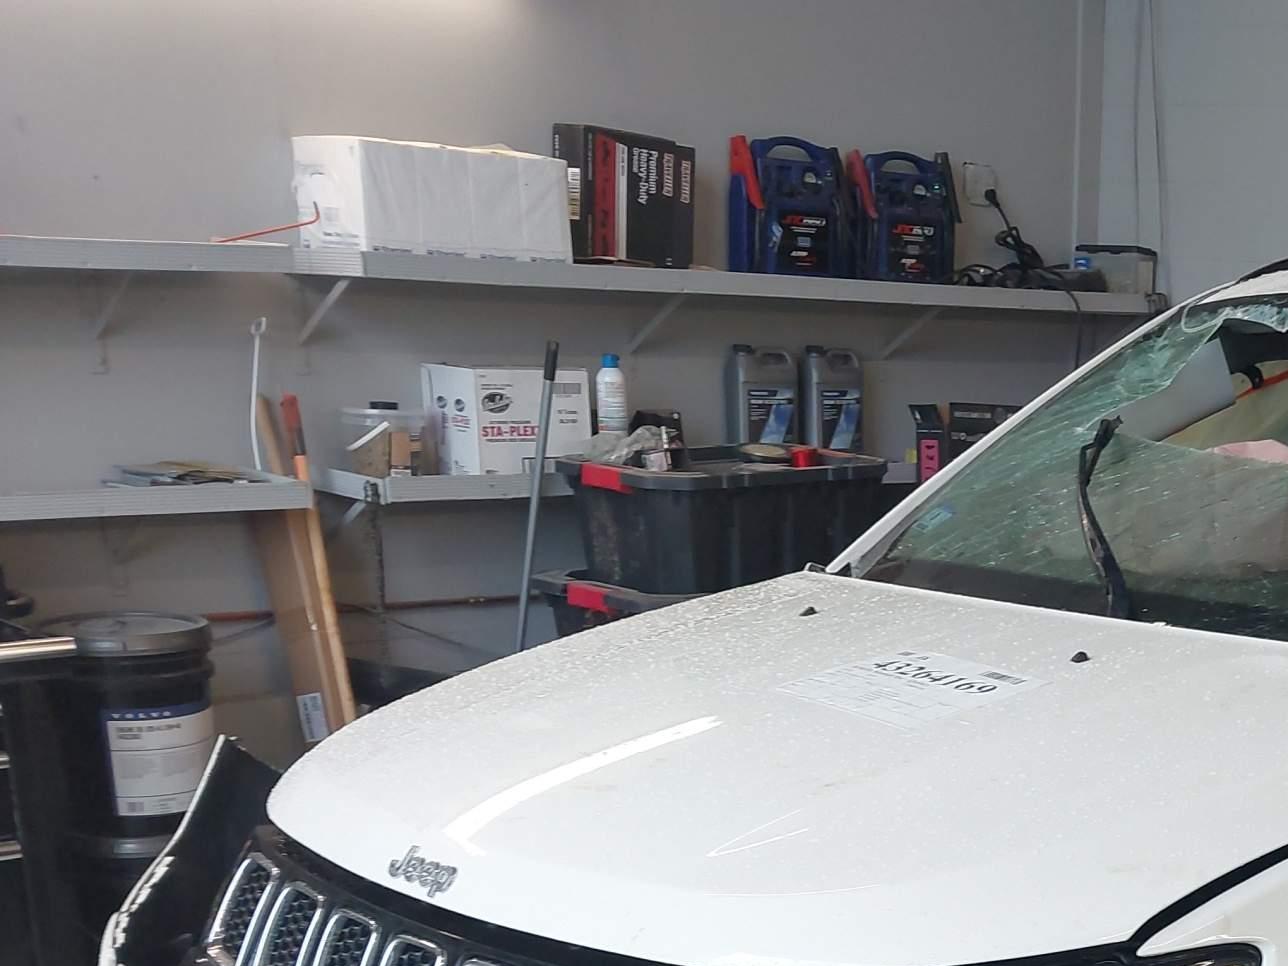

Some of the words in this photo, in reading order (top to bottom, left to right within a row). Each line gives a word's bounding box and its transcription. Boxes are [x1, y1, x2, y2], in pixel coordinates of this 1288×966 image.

[632, 147, 640, 173] Grease
[637, 148, 649, 204] Heavy-Duty
[648, 150, 659, 194] Premium
[872, 660, 998, 694] 43264169
[111, 711, 171, 719] VOLVO
[388, 845, 458, 898] Jeep
